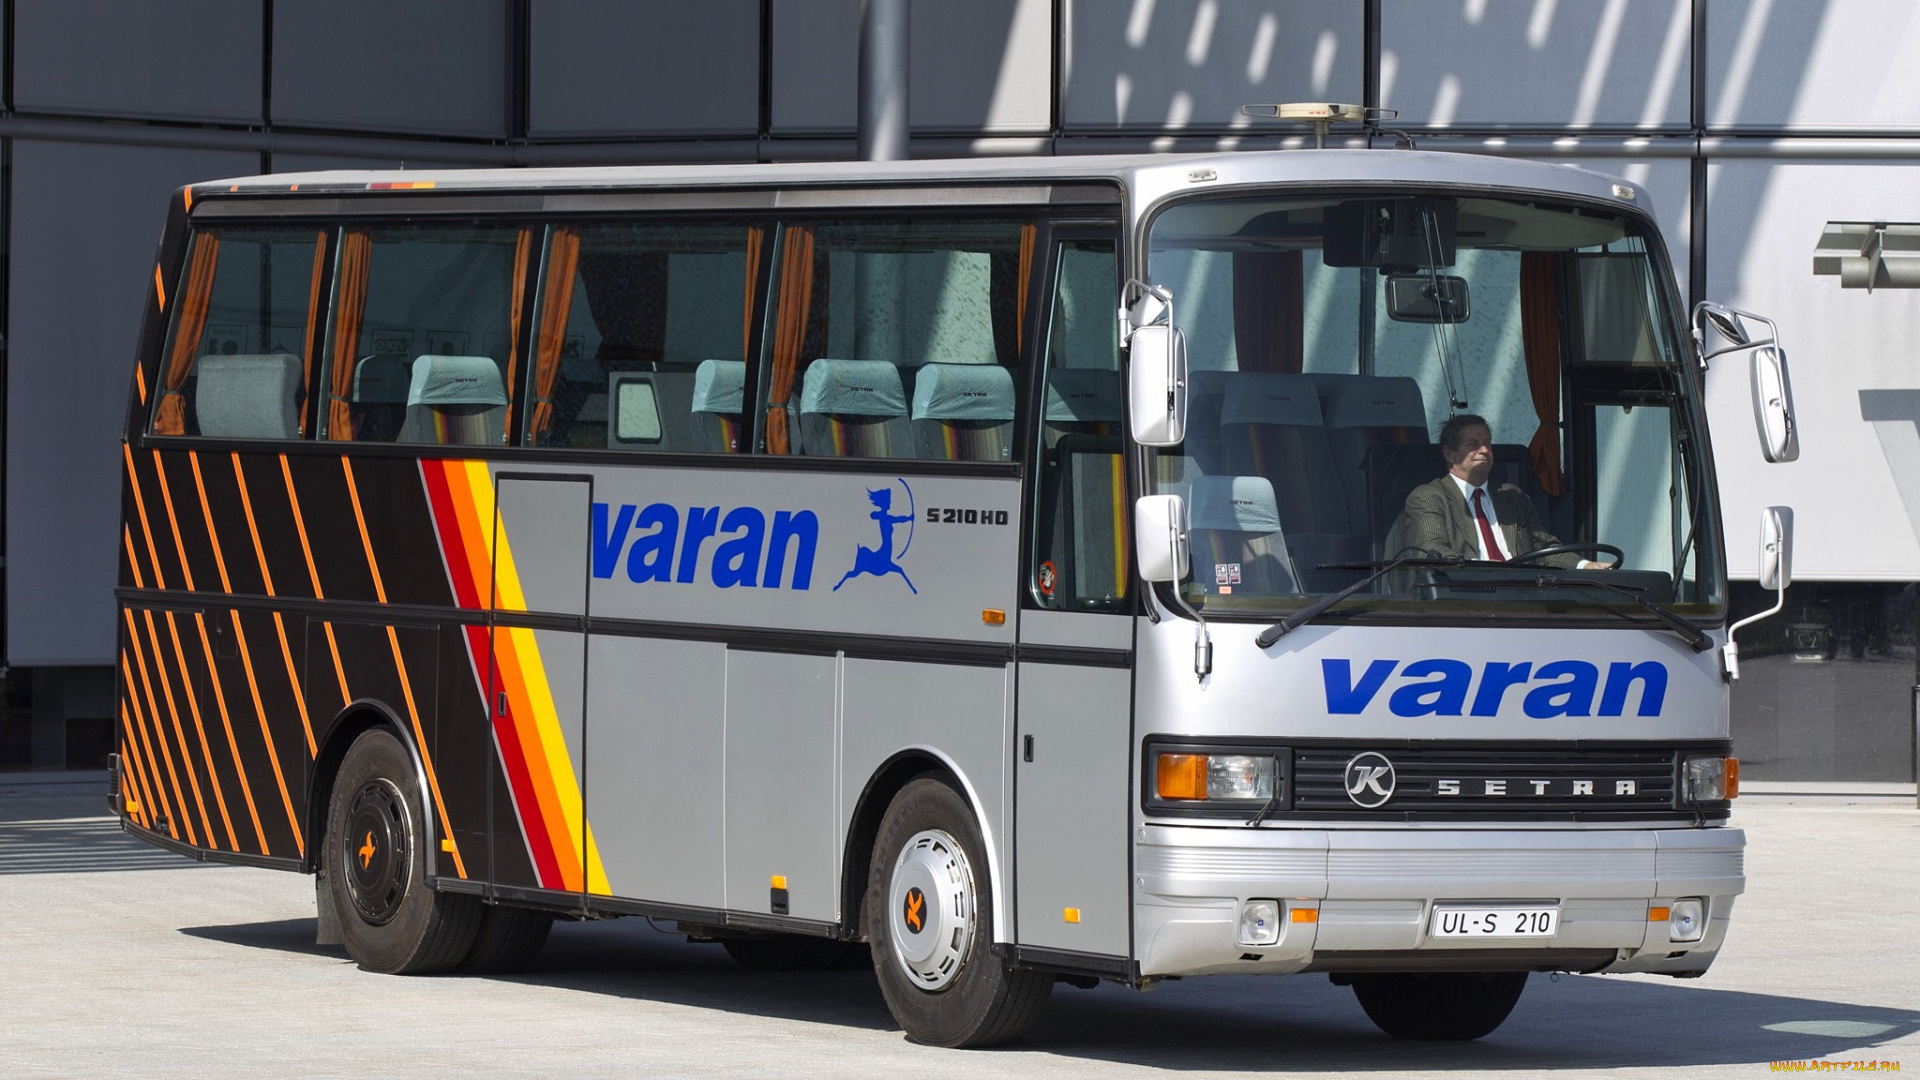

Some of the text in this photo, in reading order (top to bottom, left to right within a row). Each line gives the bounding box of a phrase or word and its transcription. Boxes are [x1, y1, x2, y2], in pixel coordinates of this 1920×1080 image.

[942, 508, 978, 525] 210
[980, 509, 1009, 526] HD
[592, 502, 819, 591] varan
[1321, 658, 1669, 719] varan
[1438, 779, 1636, 796] SETRA
[1442, 912, 1551, 934] UL-S 210
